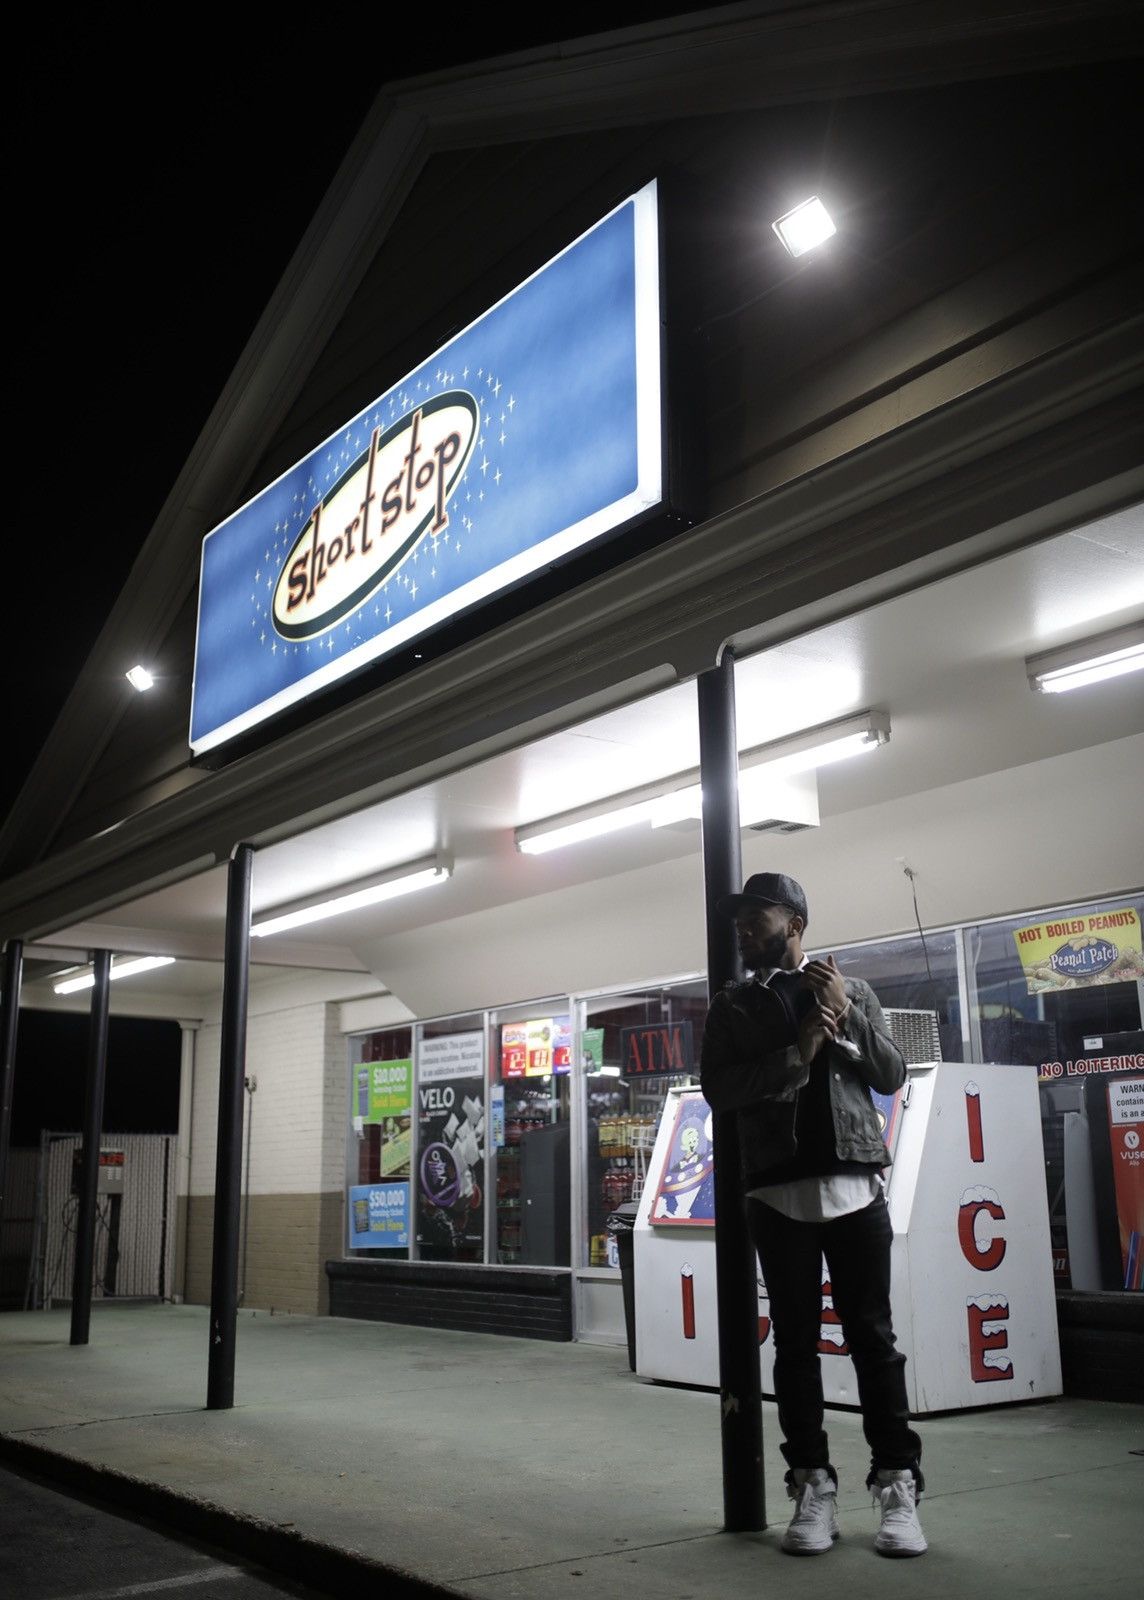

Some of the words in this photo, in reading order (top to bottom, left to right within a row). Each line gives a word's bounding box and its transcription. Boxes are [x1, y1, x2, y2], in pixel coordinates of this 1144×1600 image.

[286, 425, 381, 613] short
[380, 408, 462, 535] stop
[1018, 927, 1042, 943] HOT
[1046, 920, 1085, 938] BOILED
[1088, 911, 1136, 931] PEANUTS
[1051, 951, 1087, 969] Peanut
[1089, 944, 1119, 963] Patch
[626, 1027, 685, 1072] ATM
[1041, 1062, 1063, 1077] NO
[1067, 1054, 1144, 1076] LOITERING
[419, 1087, 455, 1109] VELO
[1130, 1110, 1139, 1118] an
[957, 1080, 1014, 1383] ICE
